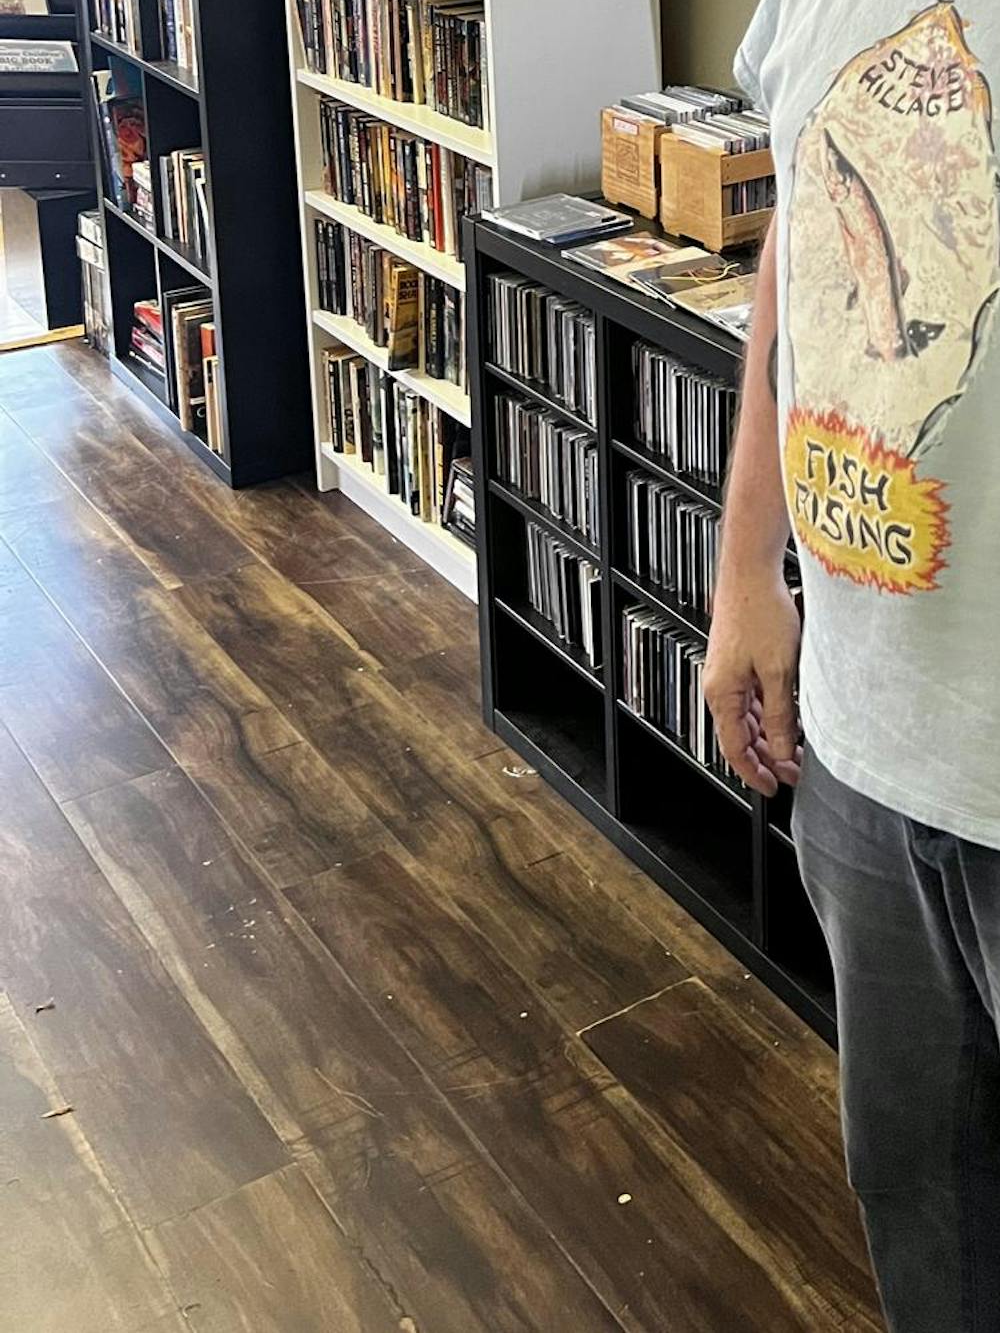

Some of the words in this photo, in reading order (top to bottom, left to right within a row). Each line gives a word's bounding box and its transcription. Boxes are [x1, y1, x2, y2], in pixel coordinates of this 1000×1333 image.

[858, 65, 964, 118] HILLAGE
[883, 49, 961, 89] STEVE
[806, 439, 890, 511] FISH
[795, 478, 913, 565] RISING
